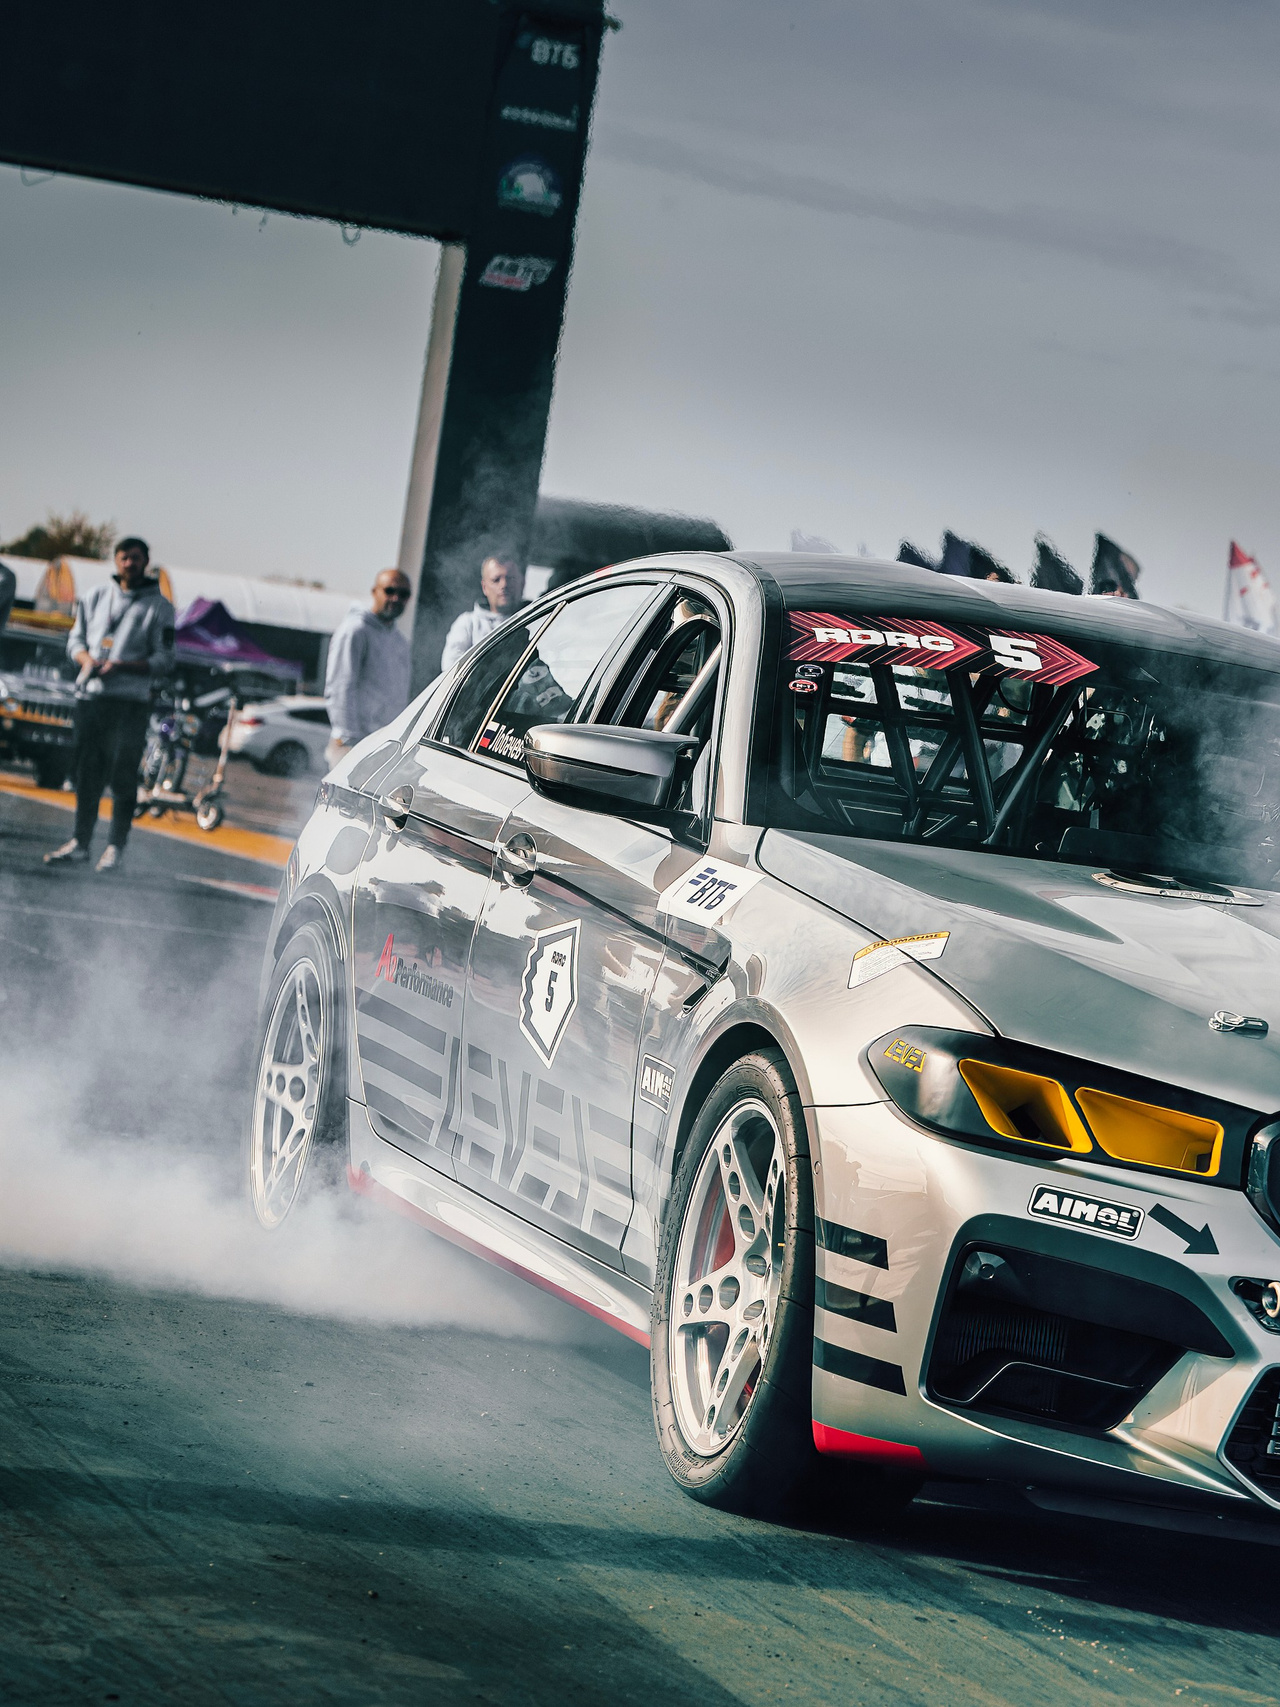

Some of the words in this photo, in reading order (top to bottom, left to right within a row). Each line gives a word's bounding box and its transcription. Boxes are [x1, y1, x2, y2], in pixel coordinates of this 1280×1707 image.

[811, 627, 955, 652] RDRC
[989, 634, 1043, 672] 5
[394, 957, 454, 1009] Performance
[545, 970, 558, 1013] 5
[1033, 1192, 1136, 1232] AIMOL
